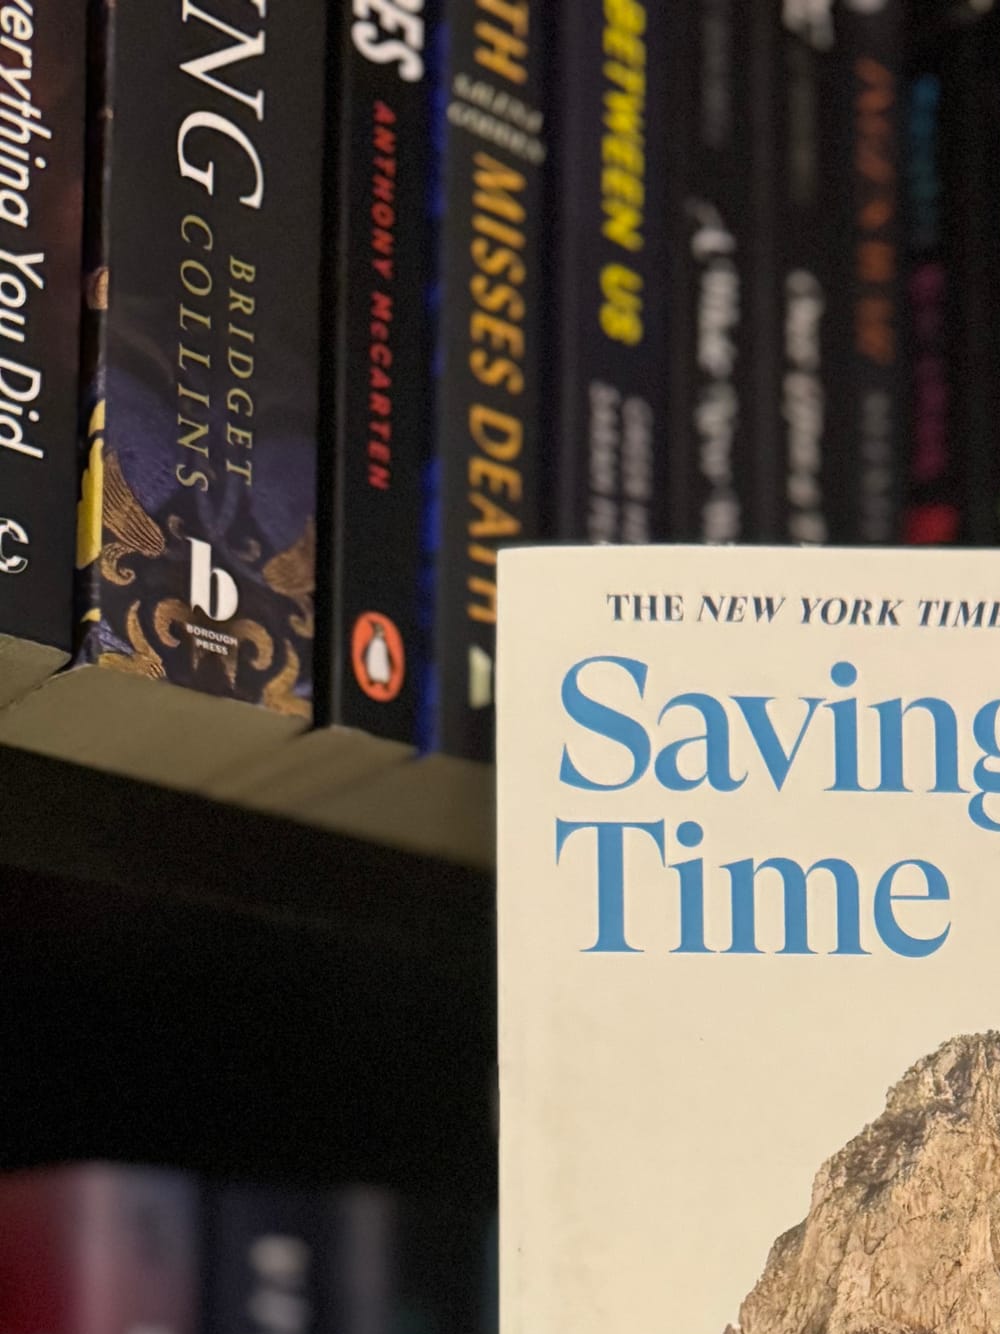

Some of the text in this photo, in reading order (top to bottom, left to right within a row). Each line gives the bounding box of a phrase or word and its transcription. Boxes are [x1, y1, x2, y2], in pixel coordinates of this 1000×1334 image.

[371, 101, 397, 280] ANTHONY
[0, 252, 44, 343] You
[469, 150, 527, 395] MISSES
[0, 355, 44, 460] Did
[176, 213, 213, 493] COLLINS
[226, 255, 256, 488] BRIDGET
[185, 623, 239, 647] BOROUGH
[195, 638, 229, 656] PRESS
[606, 594, 684, 622] THE
[697, 595, 785, 623] NEW
[800, 596, 903, 625] YORK
[555, 817, 951, 958] Time
